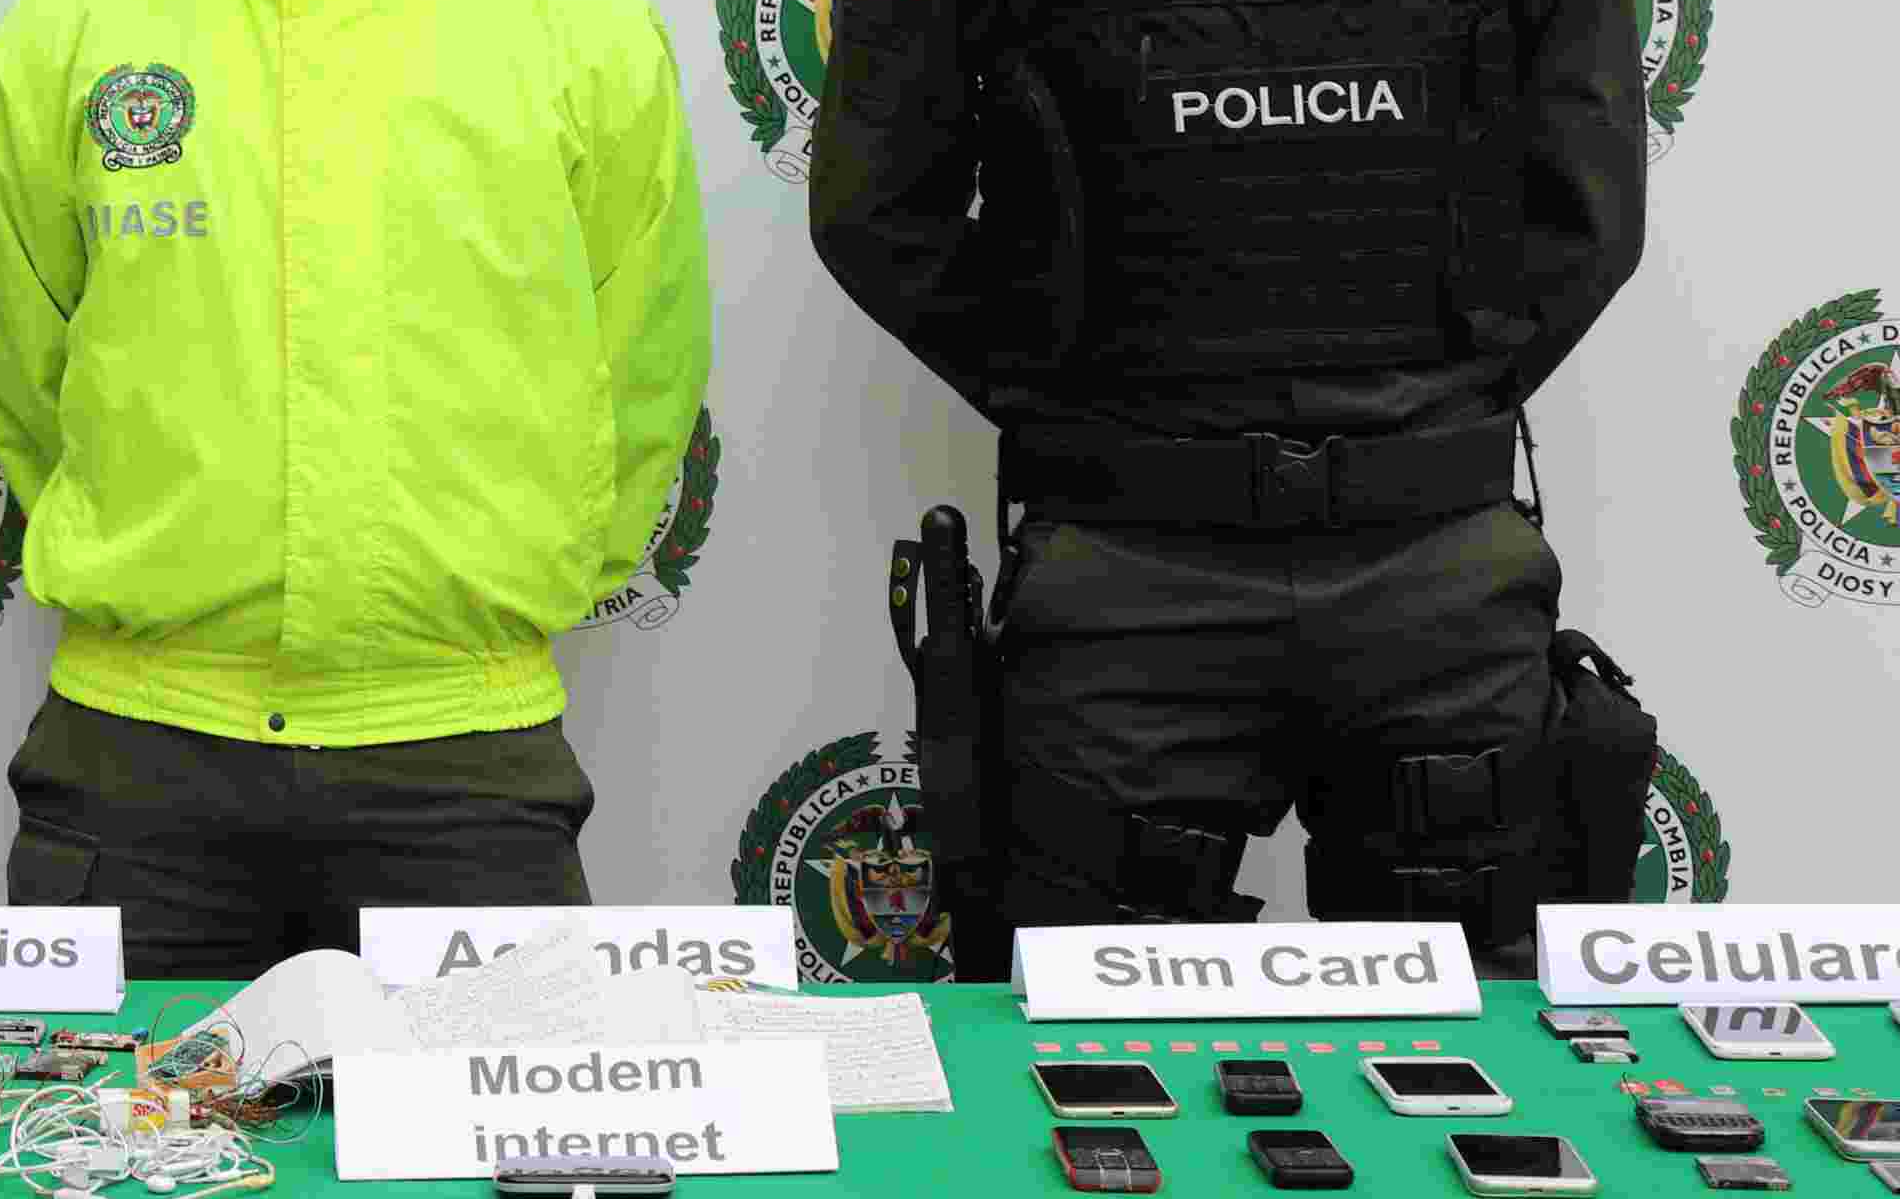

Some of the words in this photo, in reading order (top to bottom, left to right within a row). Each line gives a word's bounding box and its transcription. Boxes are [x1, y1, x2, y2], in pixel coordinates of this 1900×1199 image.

[774, 73, 820, 120] POLI
[1172, 79, 1404, 134] POLICIA
[1776, 338, 1855, 465] REPUBLICA
[1789, 495, 1870, 564] POLICIA
[582, 586, 644, 621] TRIA
[776, 780, 854, 906] REPUBLICA
[880, 767, 914, 784] DE
[1643, 790, 1688, 893] LOMBIA
[436, 928, 756, 978] Andas
[1093, 944, 1235, 987] Sim
[1260, 941, 1439, 987] Card
[1579, 927, 1900, 986] Celular
[468, 1050, 704, 1096] Modem
[473, 1122, 726, 1162] internet
